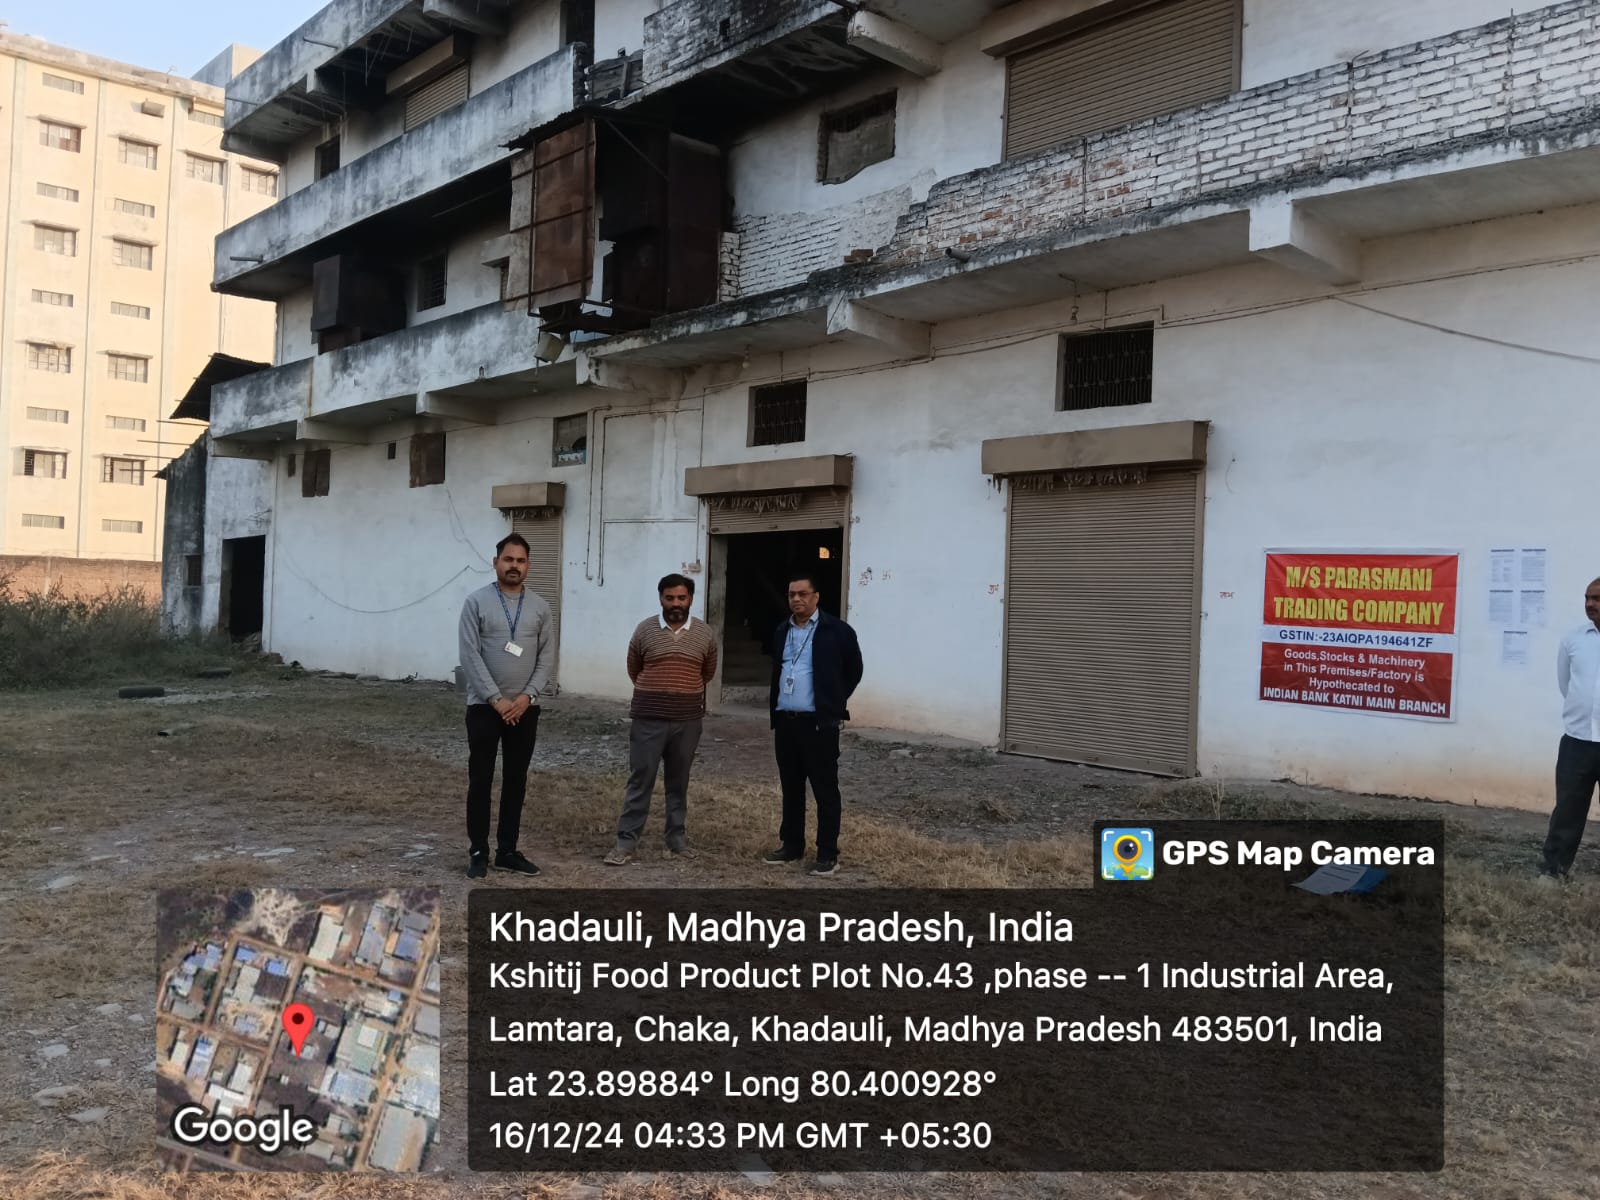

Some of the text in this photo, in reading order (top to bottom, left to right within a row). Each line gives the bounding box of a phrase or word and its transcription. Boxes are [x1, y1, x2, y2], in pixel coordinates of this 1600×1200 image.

[1285, 566, 1433, 592] M/S PARASMANI
[1273, 597, 1445, 626] TRADING COMPANY
[1283, 662, 1425, 683] in This Premises/Factory is
[1358, 653, 1365, 664] &
[1369, 654, 1425, 669] Machinery
[1309, 677, 1395, 694] Hypothecated to
[1263, 687, 1446, 714] INDIAN BANK KATNI MAIN BRANCH
